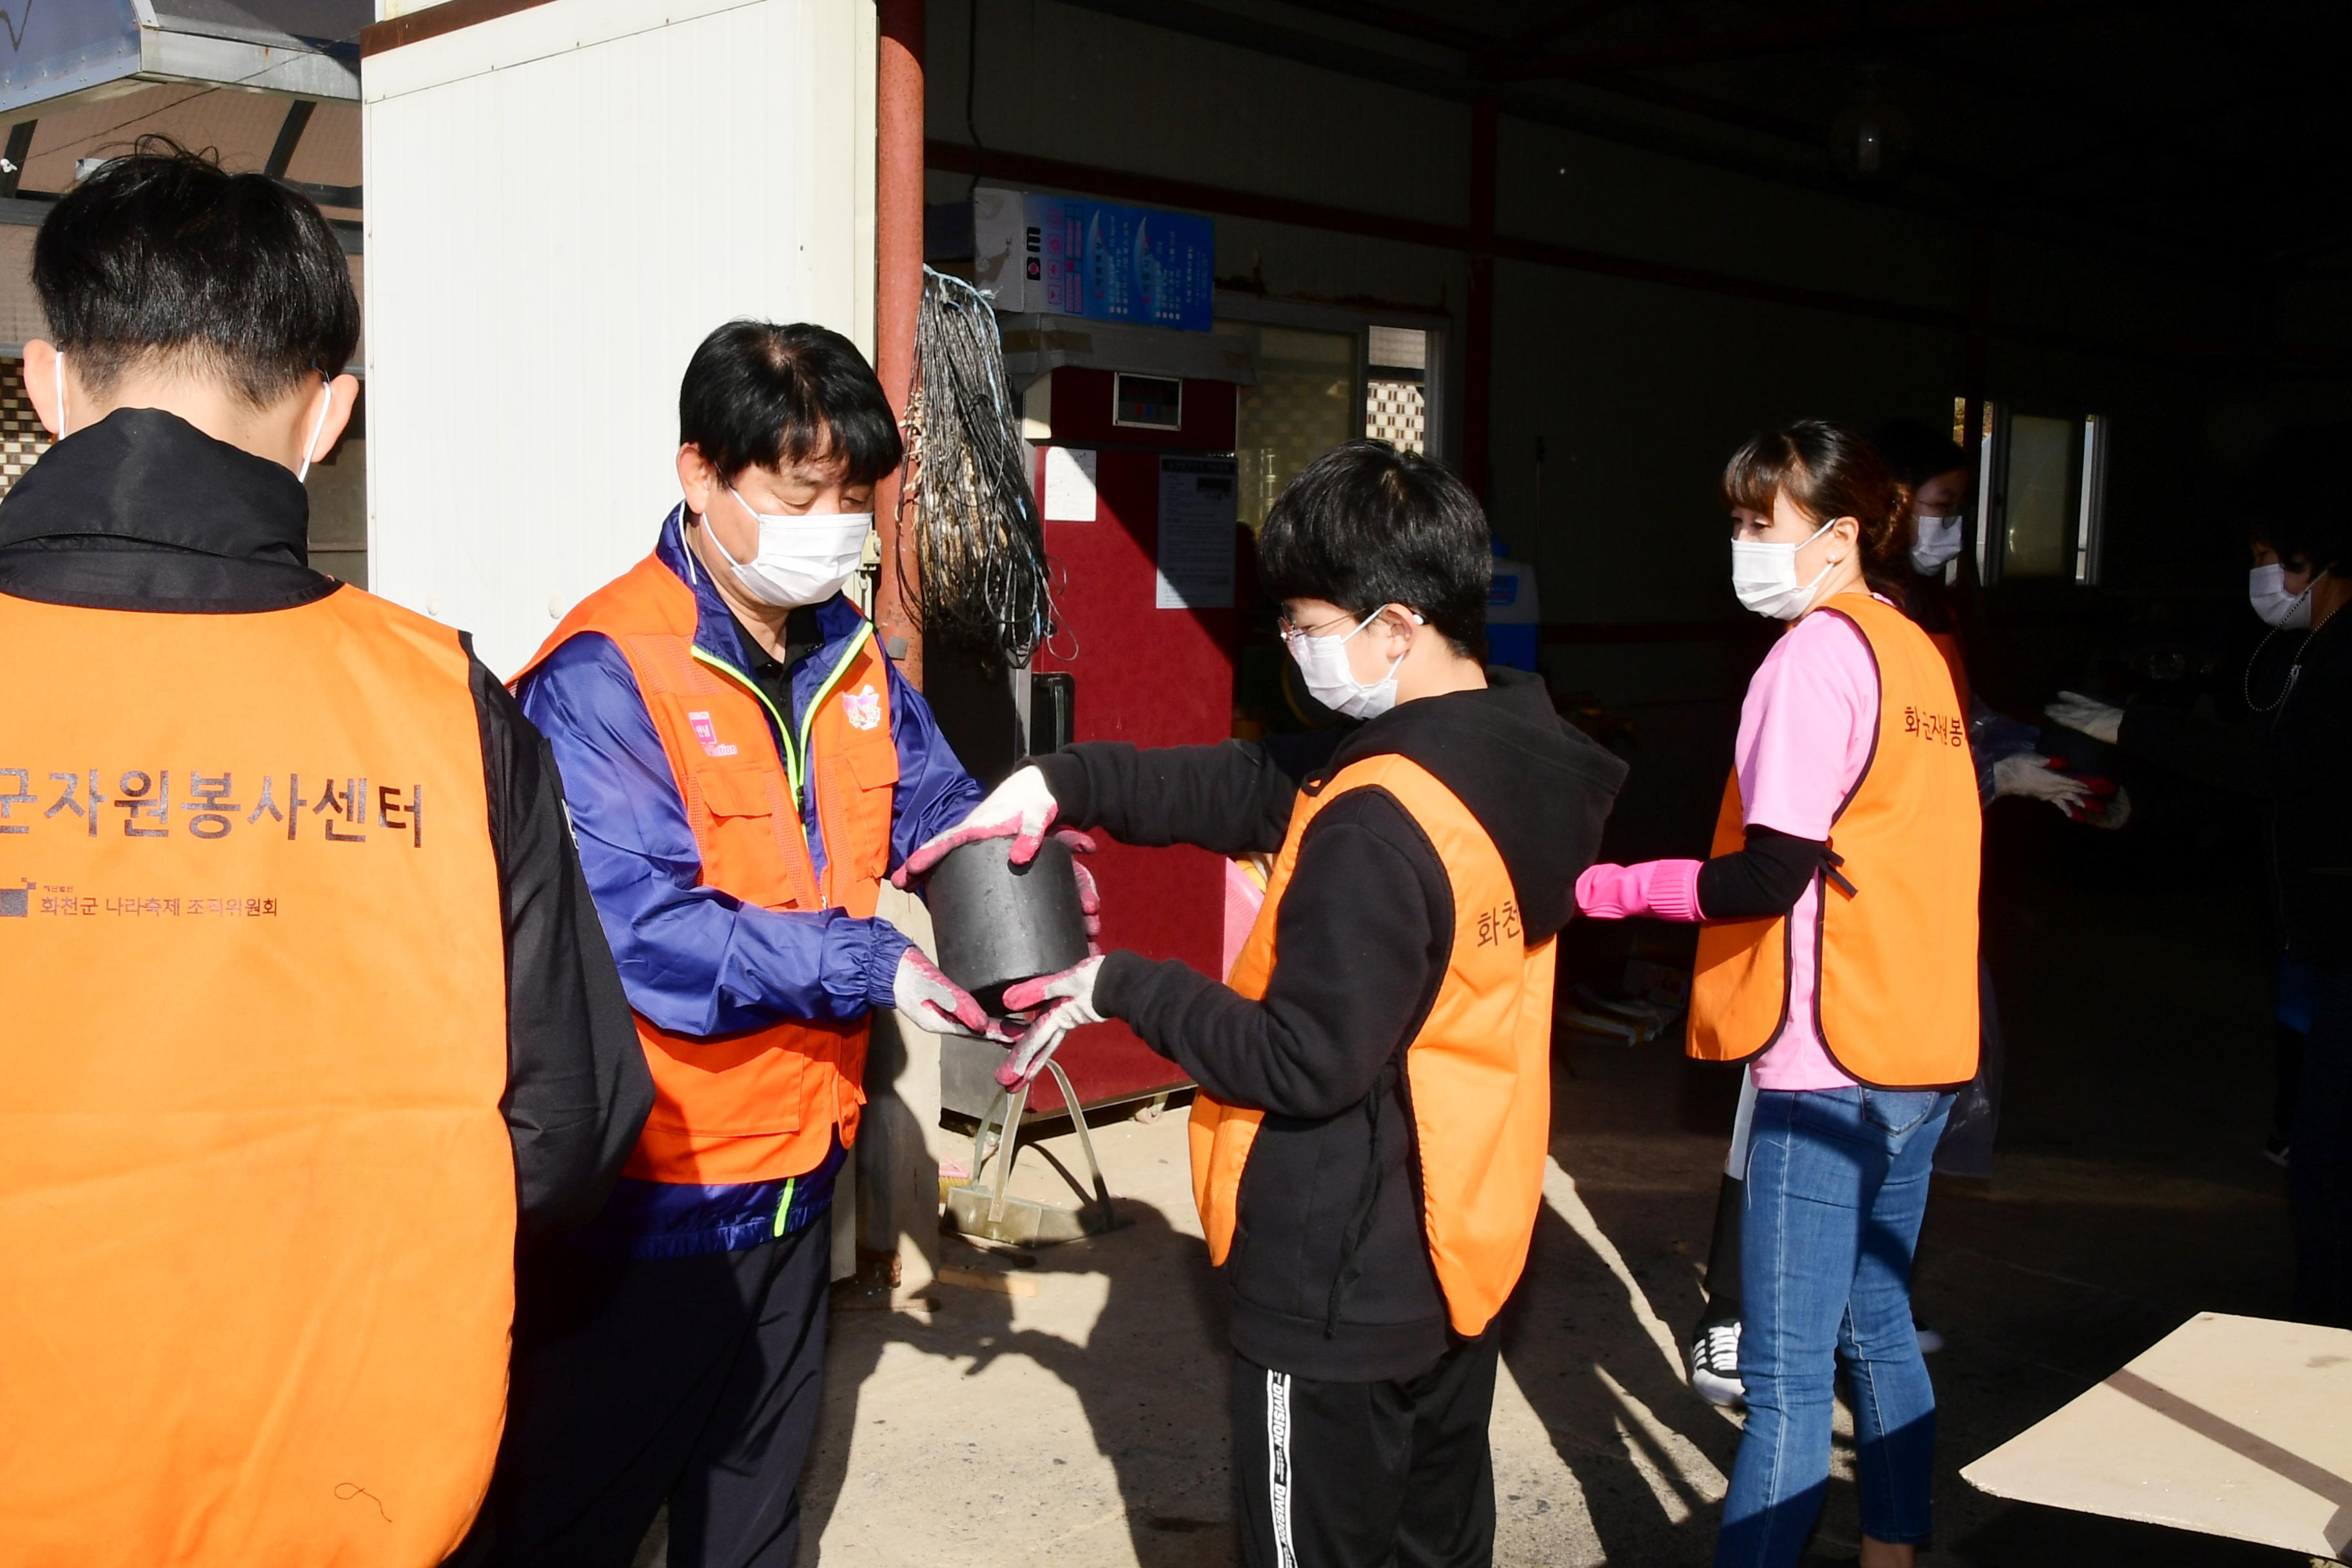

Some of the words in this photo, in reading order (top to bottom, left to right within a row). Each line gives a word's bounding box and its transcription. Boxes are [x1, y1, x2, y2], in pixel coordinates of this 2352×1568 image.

[0, 768, 422, 848] 군자원봉사센터
[40, 896, 99, 916] 화천군
[106, 897, 181, 917] 나라축제
[186, 897, 278, 917] 조직위원회
[1272, 1382, 1284, 1449] DIVISION
[1274, 1482, 1287, 1545] DIVISION
